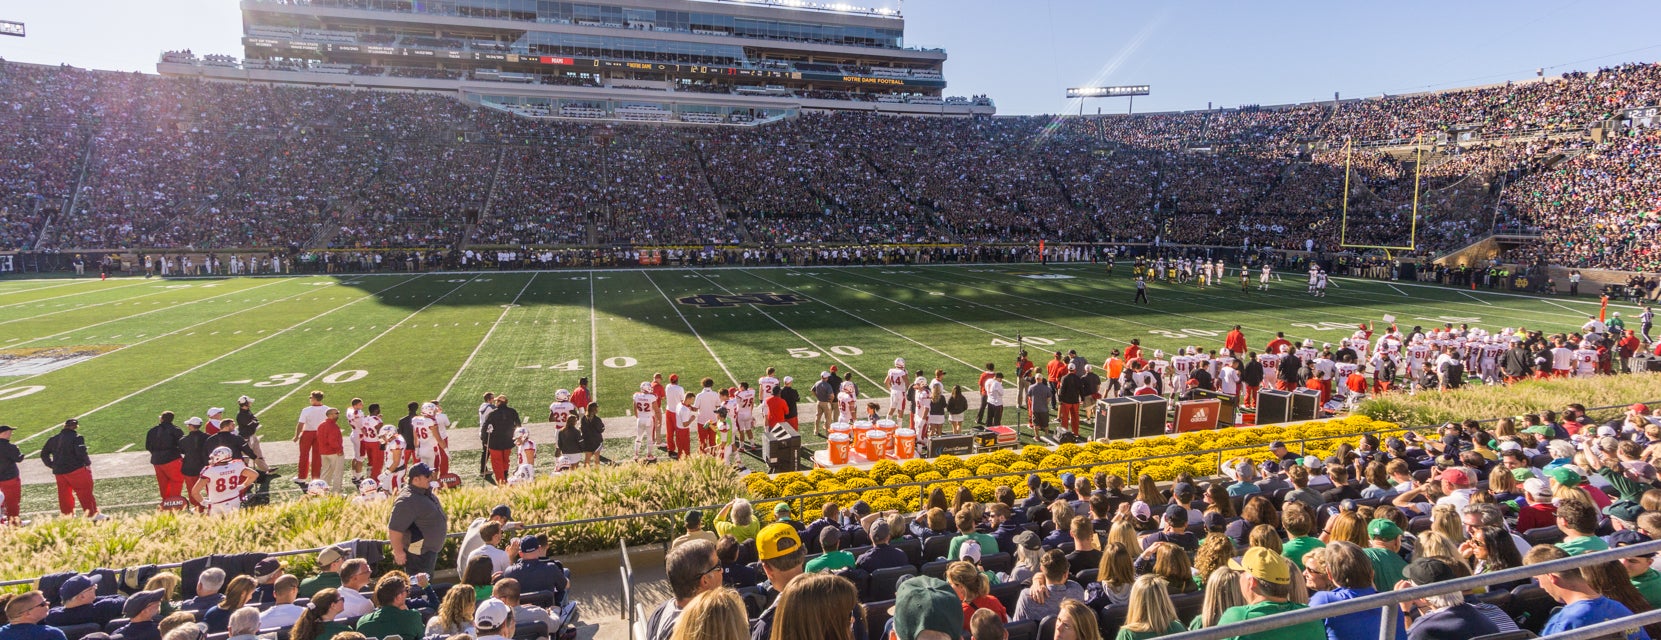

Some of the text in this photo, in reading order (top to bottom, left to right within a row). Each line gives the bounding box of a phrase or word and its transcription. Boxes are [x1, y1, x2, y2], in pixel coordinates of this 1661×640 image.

[786, 346, 862, 358] 50
[549, 357, 638, 371] 40
[1177, 363, 1185, 371] 11
[254, 370, 369, 388] 30
[766, 385, 771, 394] 2
[636, 402, 650, 412] 62
[554, 412, 567, 422] 23
[216, 476, 237, 492] 89
